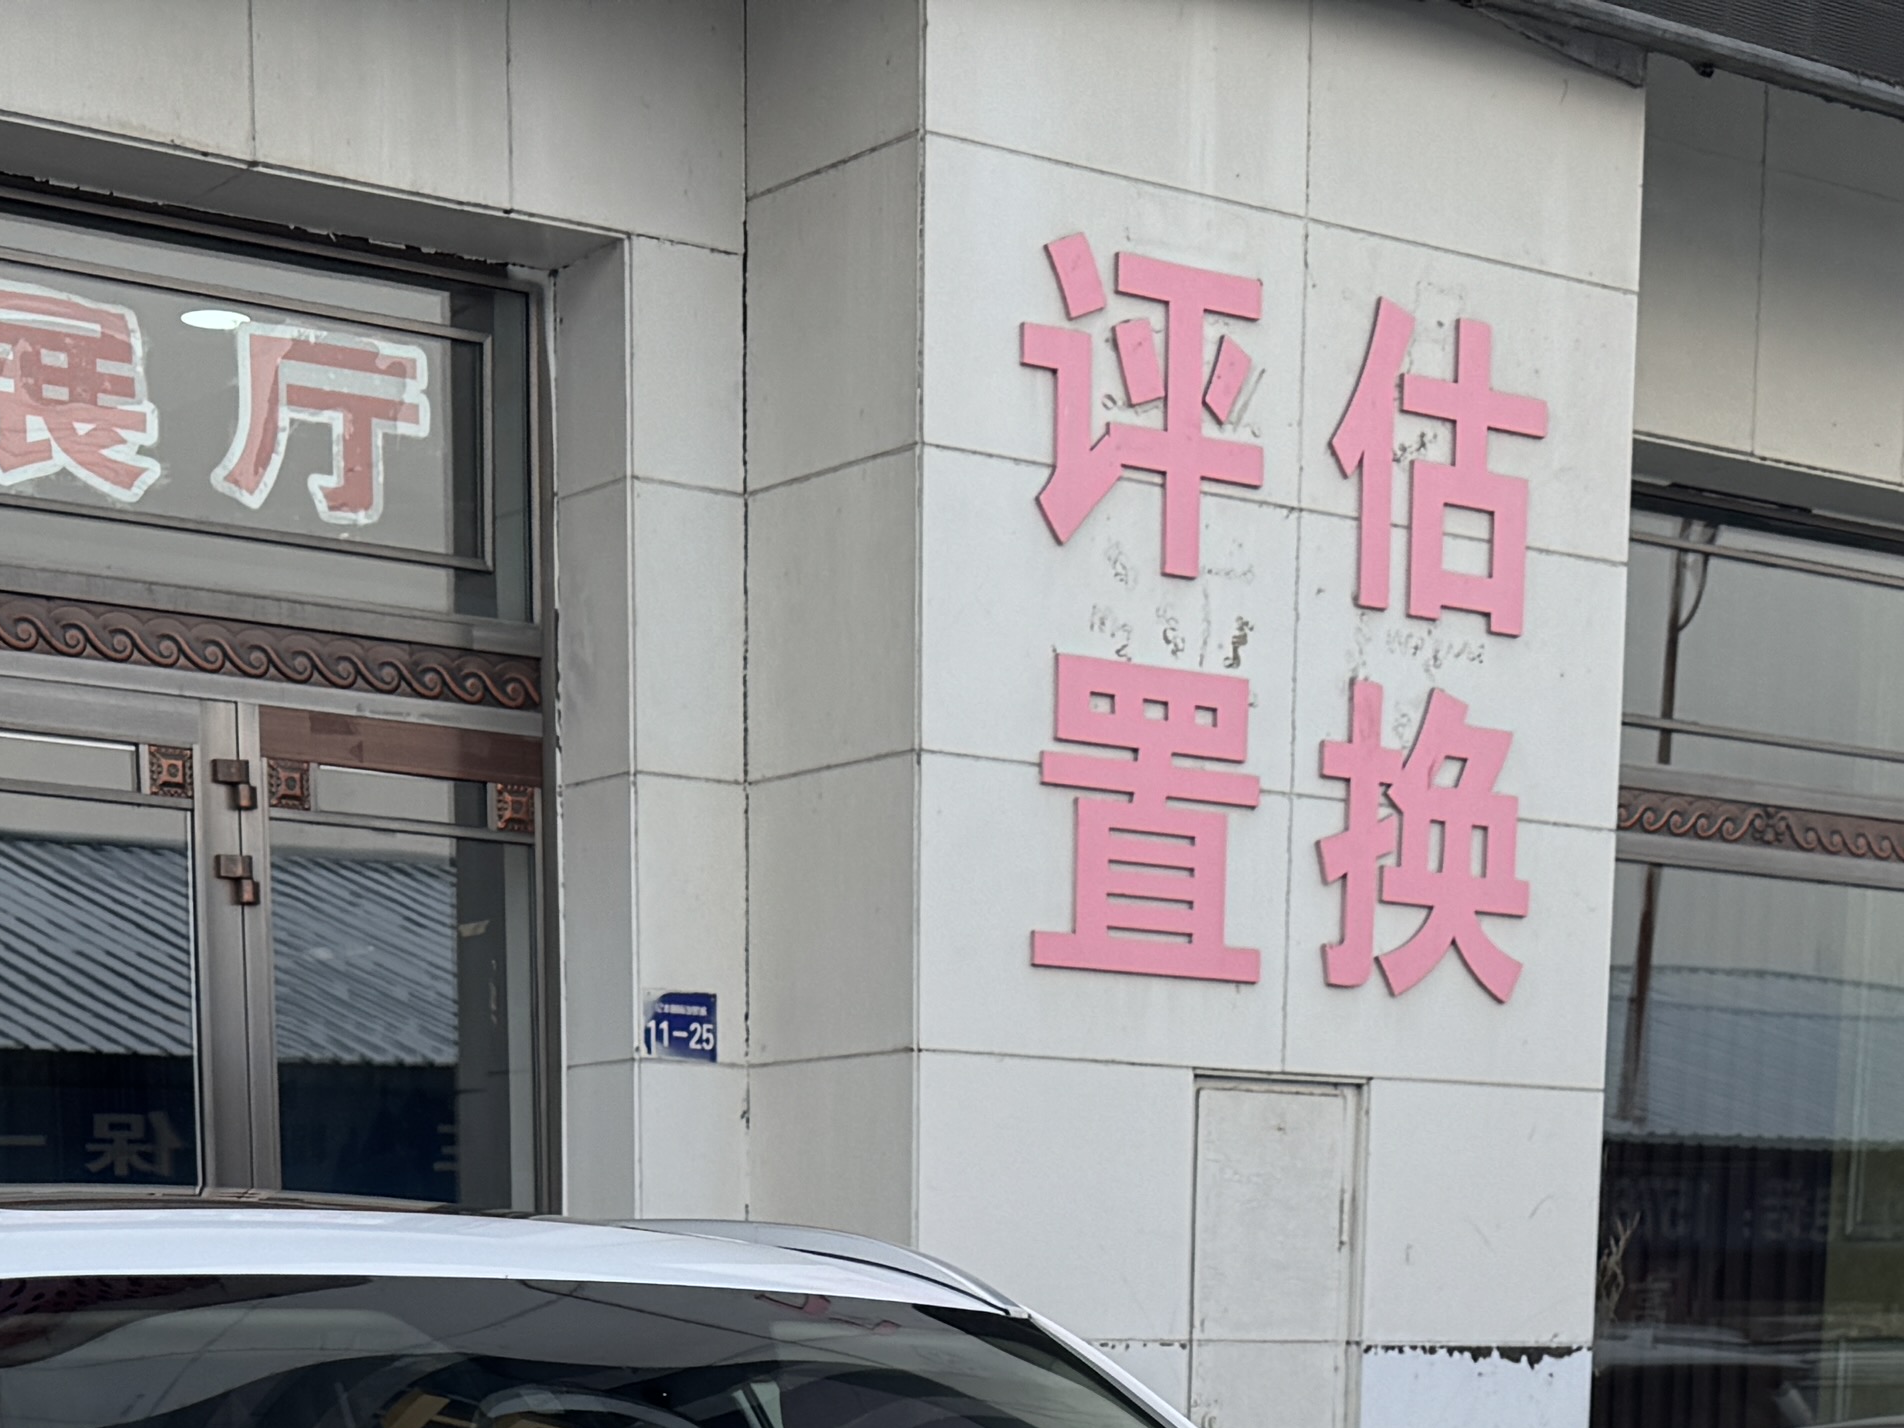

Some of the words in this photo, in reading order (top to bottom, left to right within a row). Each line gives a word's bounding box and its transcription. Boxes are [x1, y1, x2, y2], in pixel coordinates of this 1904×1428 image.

[1020, 232, 1548, 637] 评估
[1030, 651, 1530, 1003] 置换
[646, 1019, 715, 1051] 11-25
